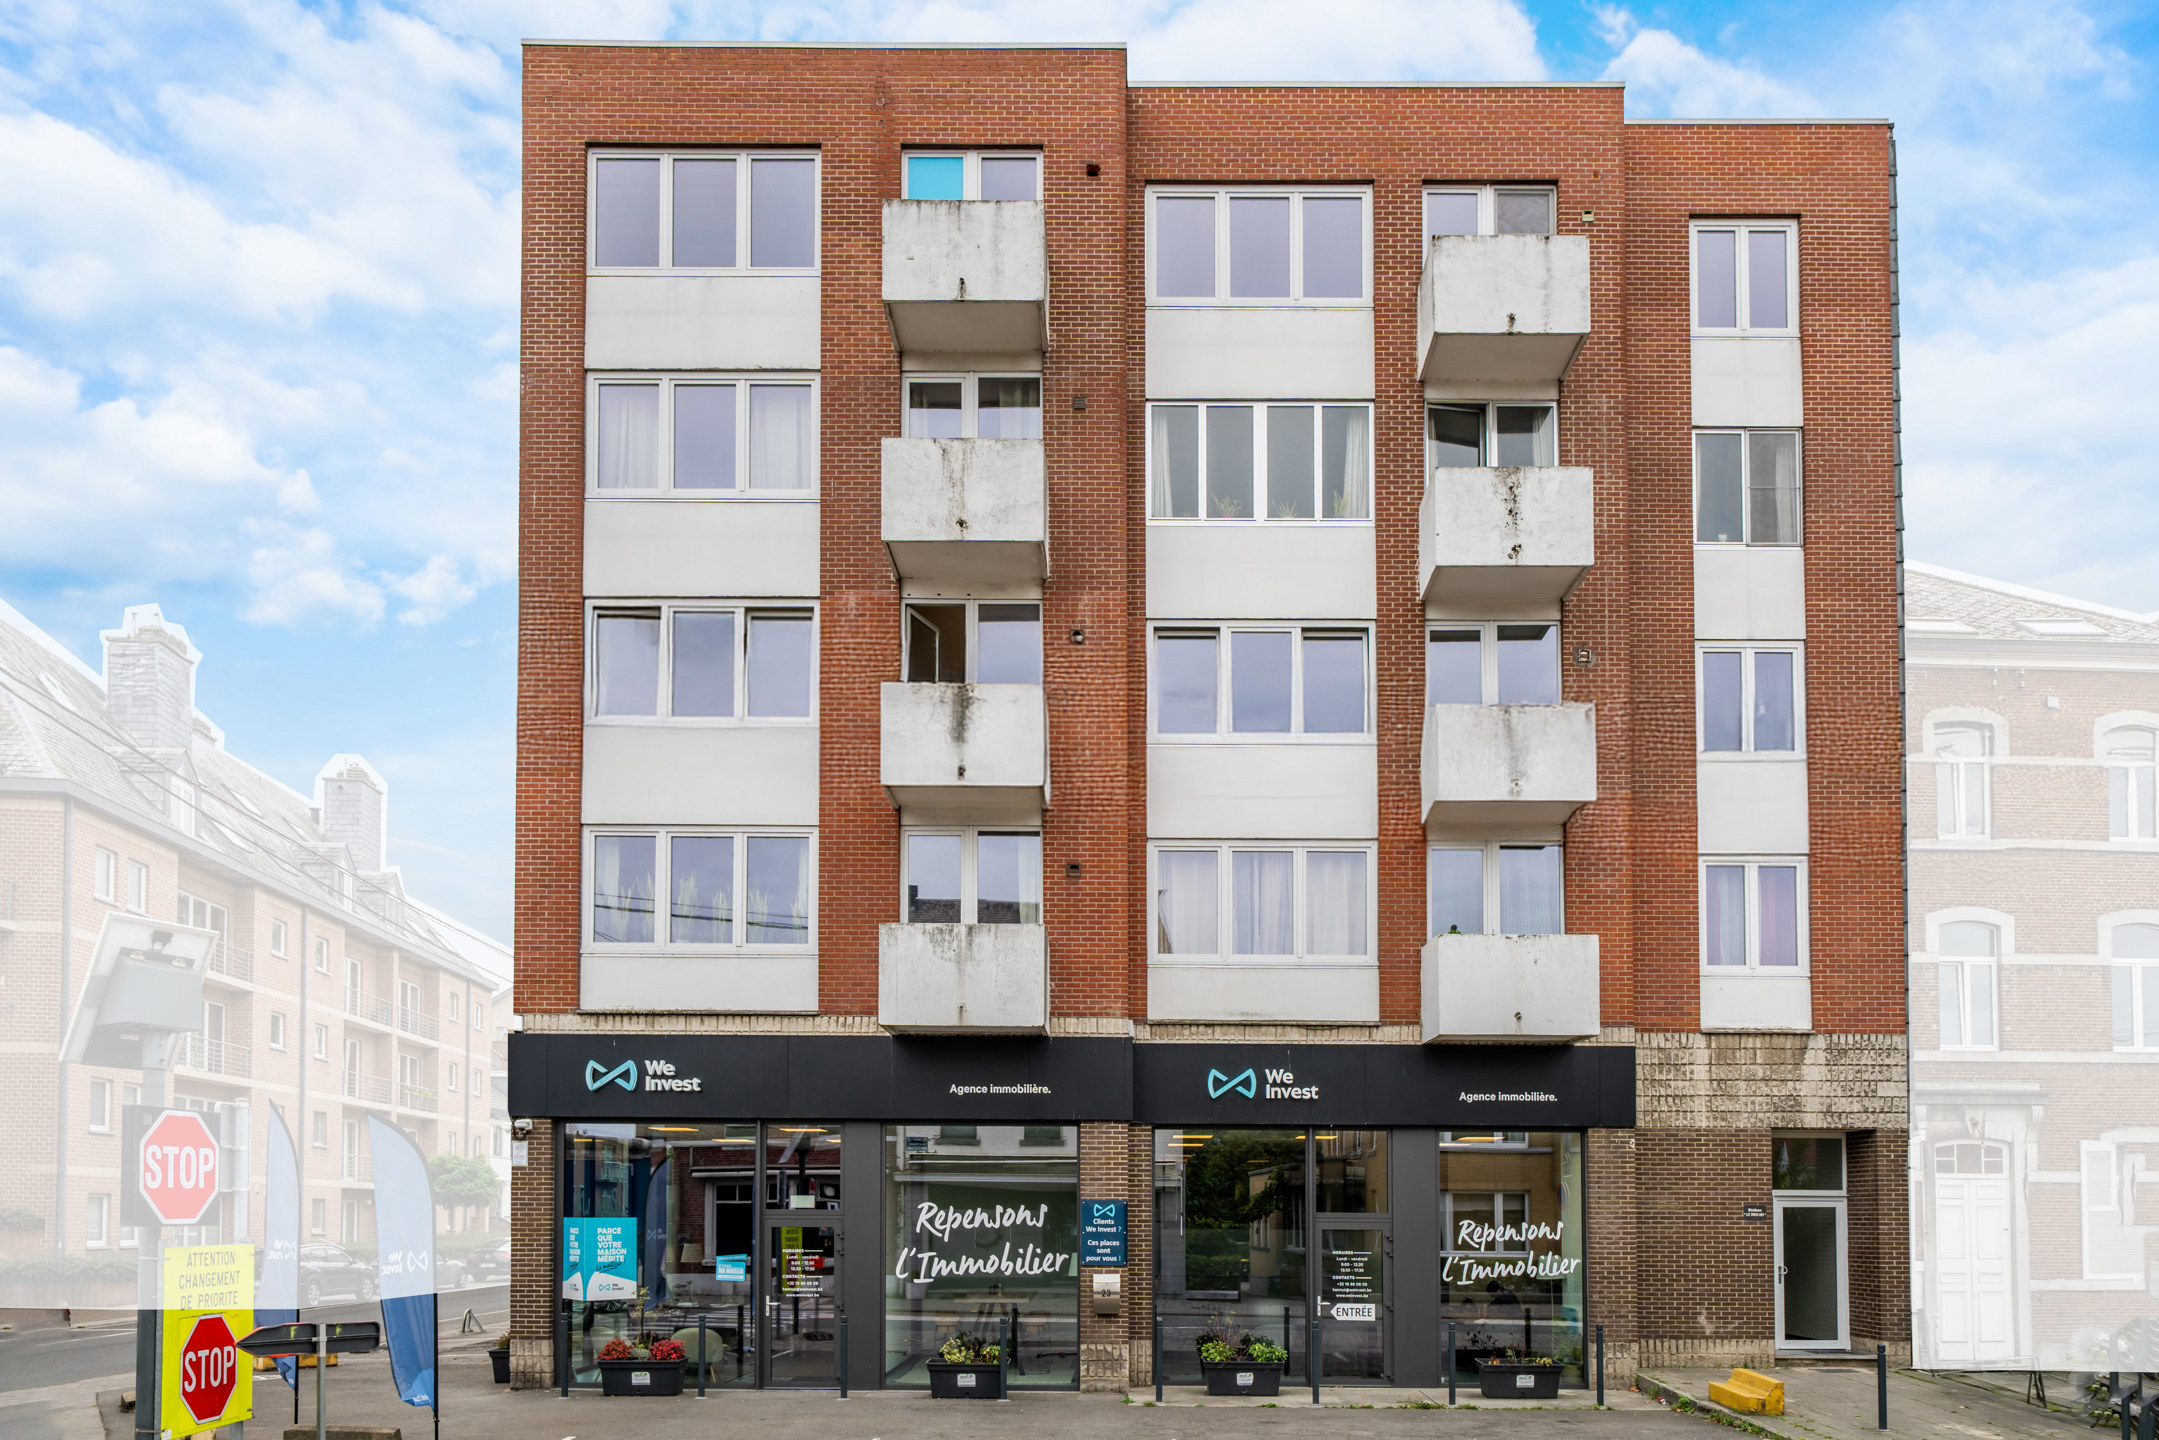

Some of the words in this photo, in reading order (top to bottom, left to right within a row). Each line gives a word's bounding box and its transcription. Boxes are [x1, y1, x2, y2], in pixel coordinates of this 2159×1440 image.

[645, 1060, 676, 1076] We
[1265, 1068, 1294, 1084] We
[645, 1076, 701, 1091] Invest
[950, 1084, 988, 1096] Agence
[990, 1084, 1051, 1094] immobilière.
[1266, 1084, 1318, 1099] Invest
[1459, 1092, 1496, 1103] Agence
[1498, 1092, 1558, 1102] immobilière.
[145, 1144, 214, 1189] STOP
[916, 1202, 1048, 1242] Repensons
[1458, 1220, 1564, 1252] Repensons
[186, 1251, 236, 1268] ATTENTION
[179, 1270, 240, 1290] CHANGEMENT
[181, 1296, 192, 1310] DE
[198, 1291, 238, 1309] PRIORITE
[1101, 1289, 1111, 1297] 23
[1336, 1305, 1372, 1317] ENTRÉE
[184, 1346, 234, 1392] STOP
